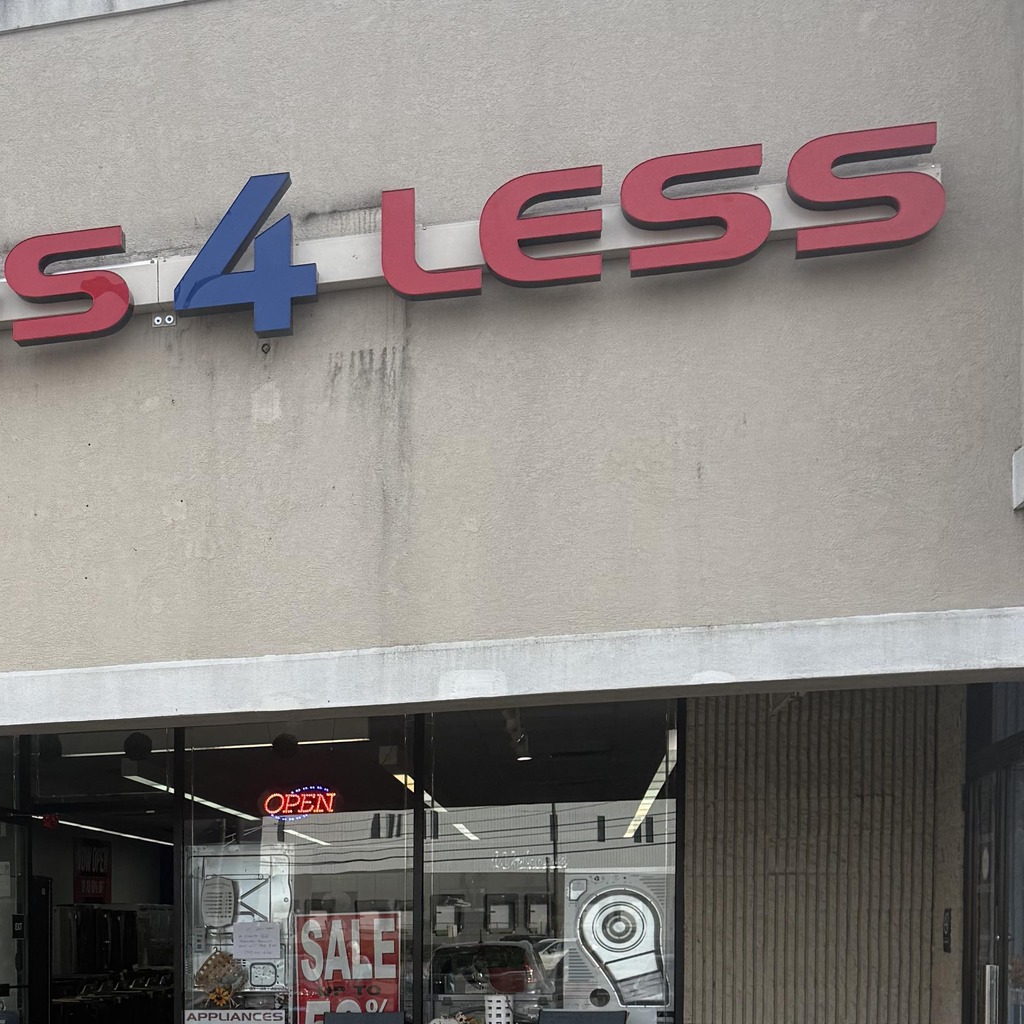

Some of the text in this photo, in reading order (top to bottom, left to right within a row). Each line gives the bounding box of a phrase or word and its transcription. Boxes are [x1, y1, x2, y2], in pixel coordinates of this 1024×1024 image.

[174, 172, 319, 338] 4
[382, 122, 947, 300] LESS
[264, 792, 336, 814] OPEN
[301, 918, 397, 982] SALE
[317, 984, 382, 997] UP TO
[186, 1012, 283, 1021] APPLIANCES
